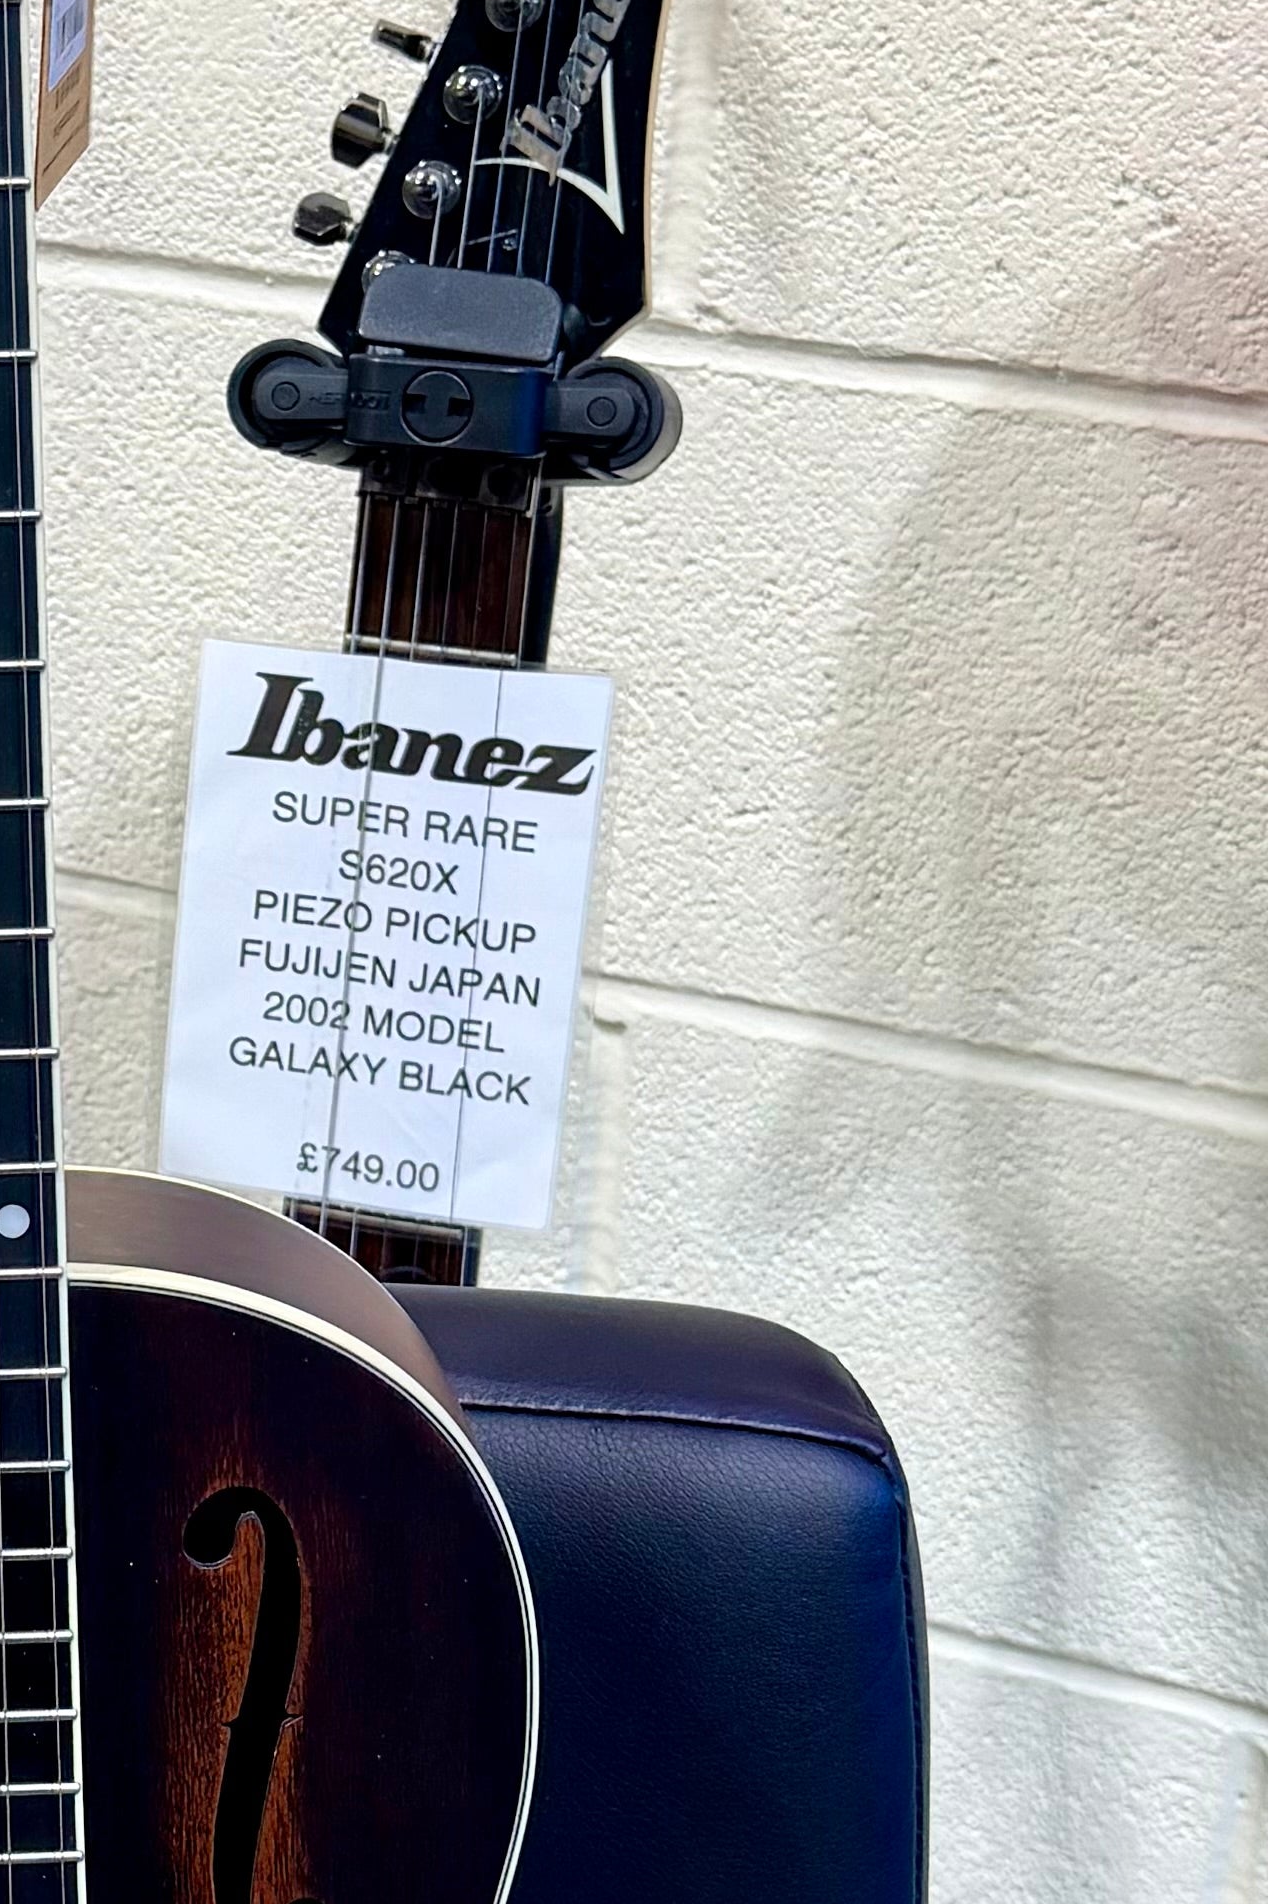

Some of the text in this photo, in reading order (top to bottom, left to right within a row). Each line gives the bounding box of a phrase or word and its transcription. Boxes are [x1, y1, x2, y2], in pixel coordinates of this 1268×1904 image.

[226, 672, 596, 795] Ibanez
[272, 791, 538, 853] SUPER RARE
[339, 849, 460, 894] S620X
[253, 889, 536, 954] PIEZO PICKUP
[239, 940, 541, 1007] FUJIJEN JAPAN
[263, 991, 505, 1054] 2002 MODEL
[229, 1037, 531, 1105] GALAXY BLACK
[296, 1143, 440, 1192] £749.00
